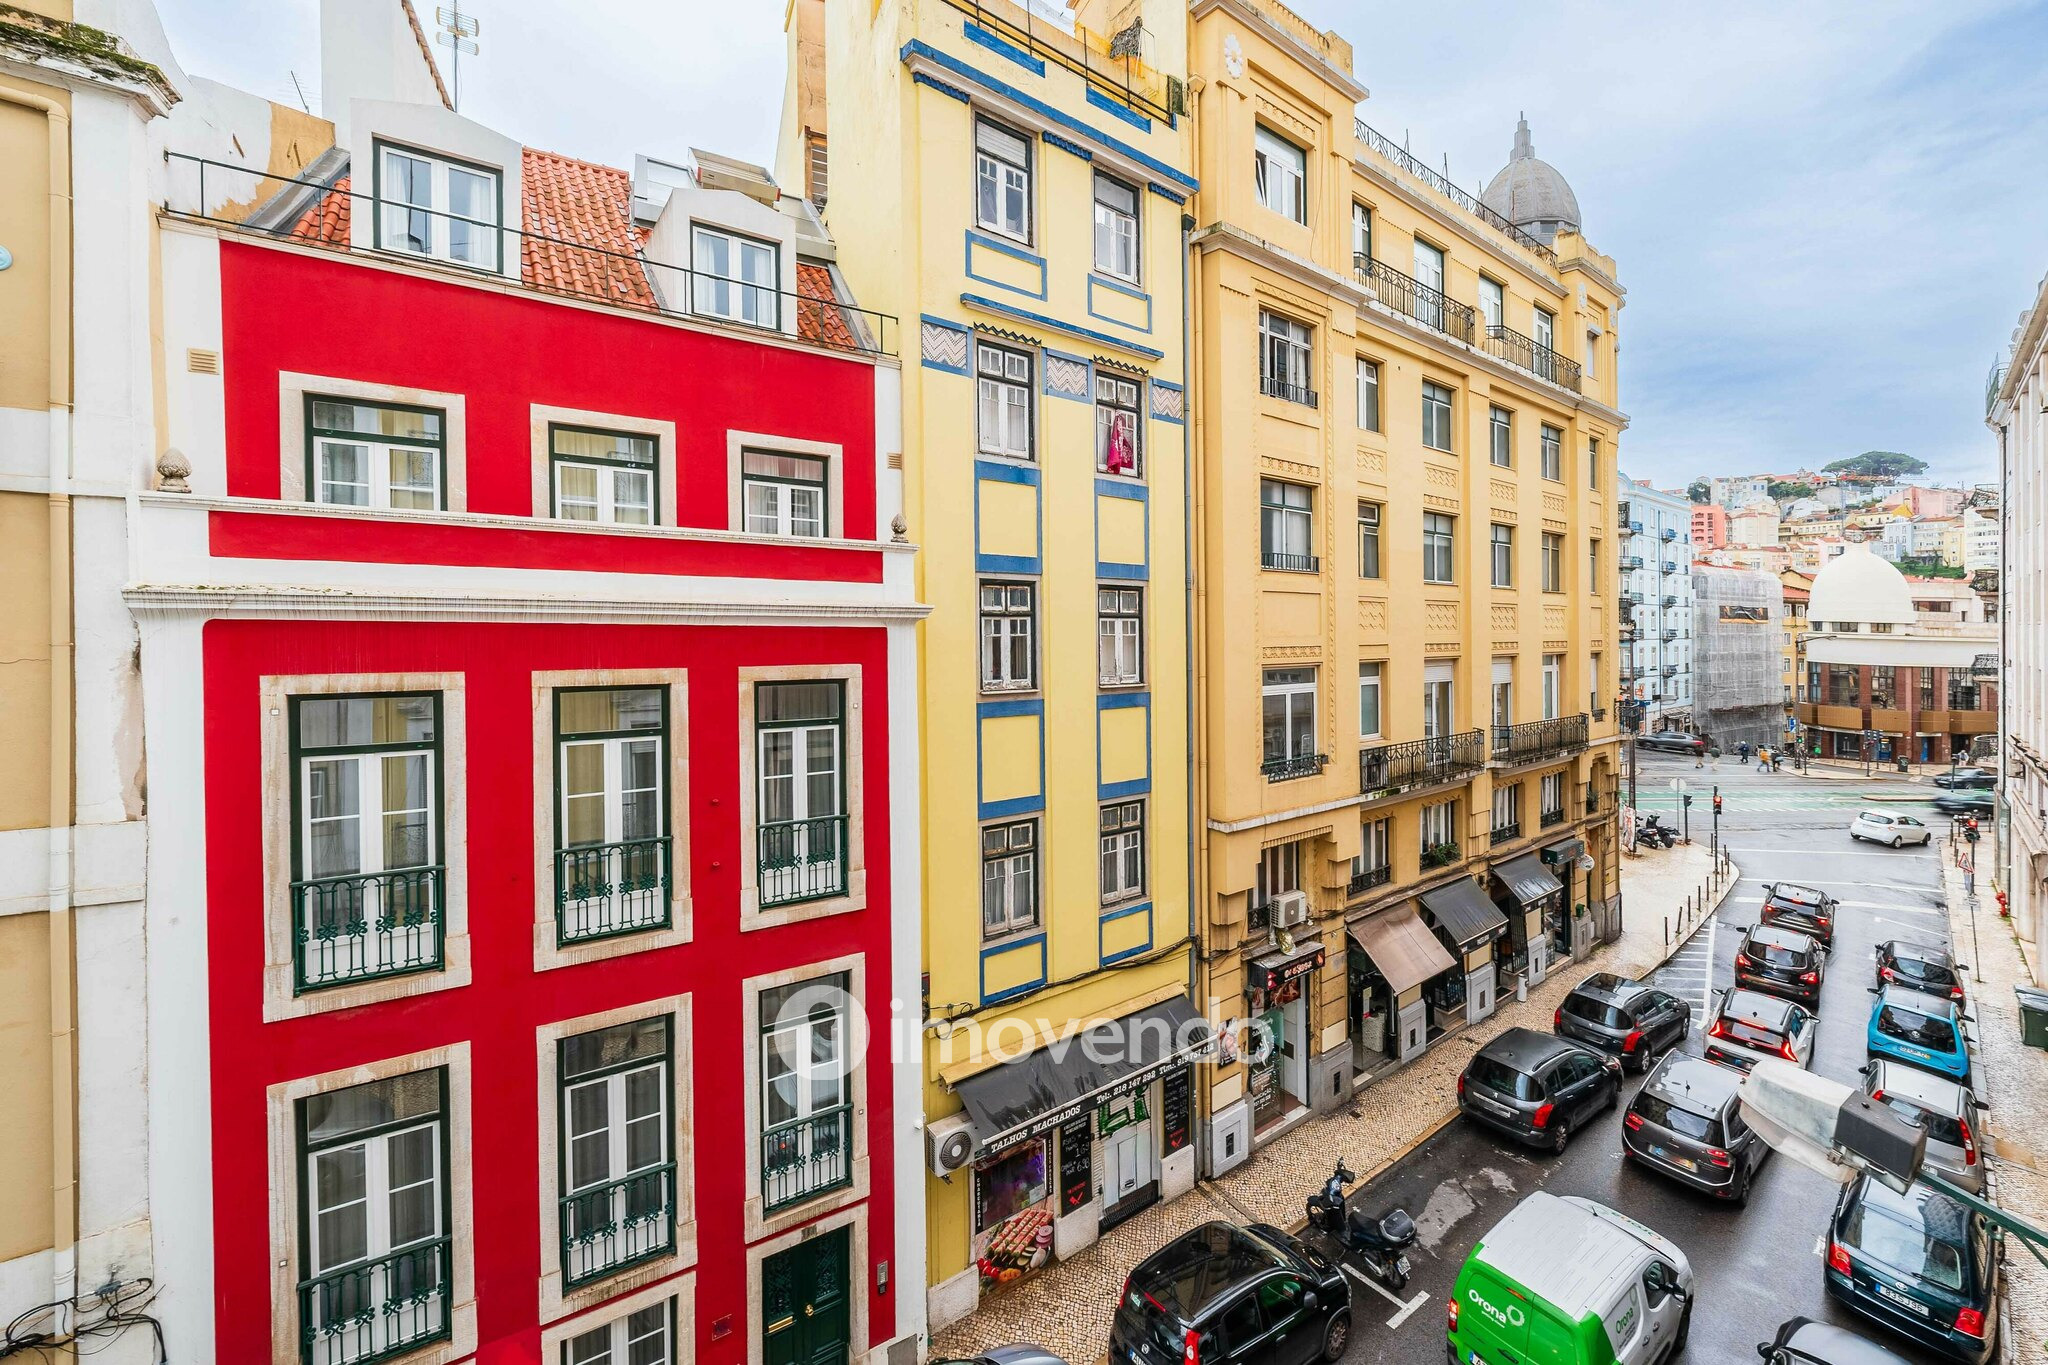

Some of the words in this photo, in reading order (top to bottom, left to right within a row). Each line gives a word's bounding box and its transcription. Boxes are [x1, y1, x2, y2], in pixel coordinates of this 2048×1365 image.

[991, 1129, 1028, 1153] TALHOS
[1032, 1105, 1081, 1134] MACHADOS
[1113, 1083, 1127, 1096] 218
[1128, 1077, 1142, 1089] 147
[1142, 1070, 1156, 1083] 292
[1468, 1289, 1507, 1324] Orona
[1615, 1307, 1634, 1334] Orona
